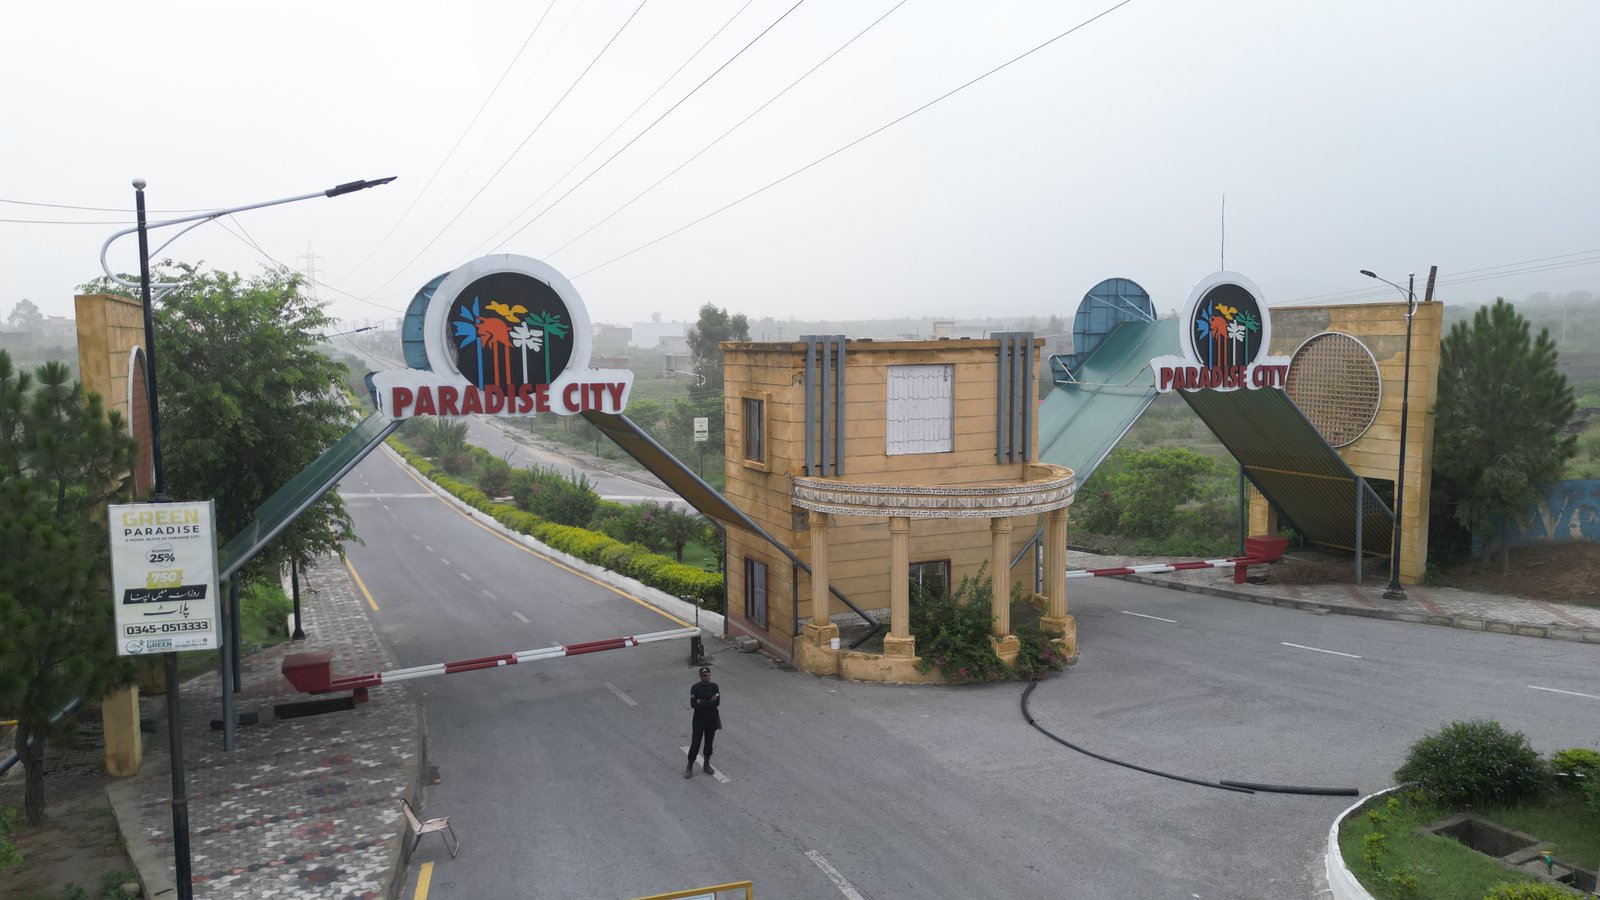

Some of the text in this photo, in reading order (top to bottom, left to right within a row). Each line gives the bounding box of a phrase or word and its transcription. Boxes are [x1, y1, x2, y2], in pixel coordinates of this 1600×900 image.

[1160, 364, 1289, 390] PARADISE CITY
[392, 382, 626, 417] PARADISE CITY
[122, 509, 199, 527] GREEN
[124, 525, 200, 536] PARADISE
[149, 552, 176, 563] 25%
[152, 572, 177, 583] 750
[143, 601, 190, 618] پلاٹ
[126, 621, 208, 635] 0345-0513333
[146, 641, 172, 649] GREEN
